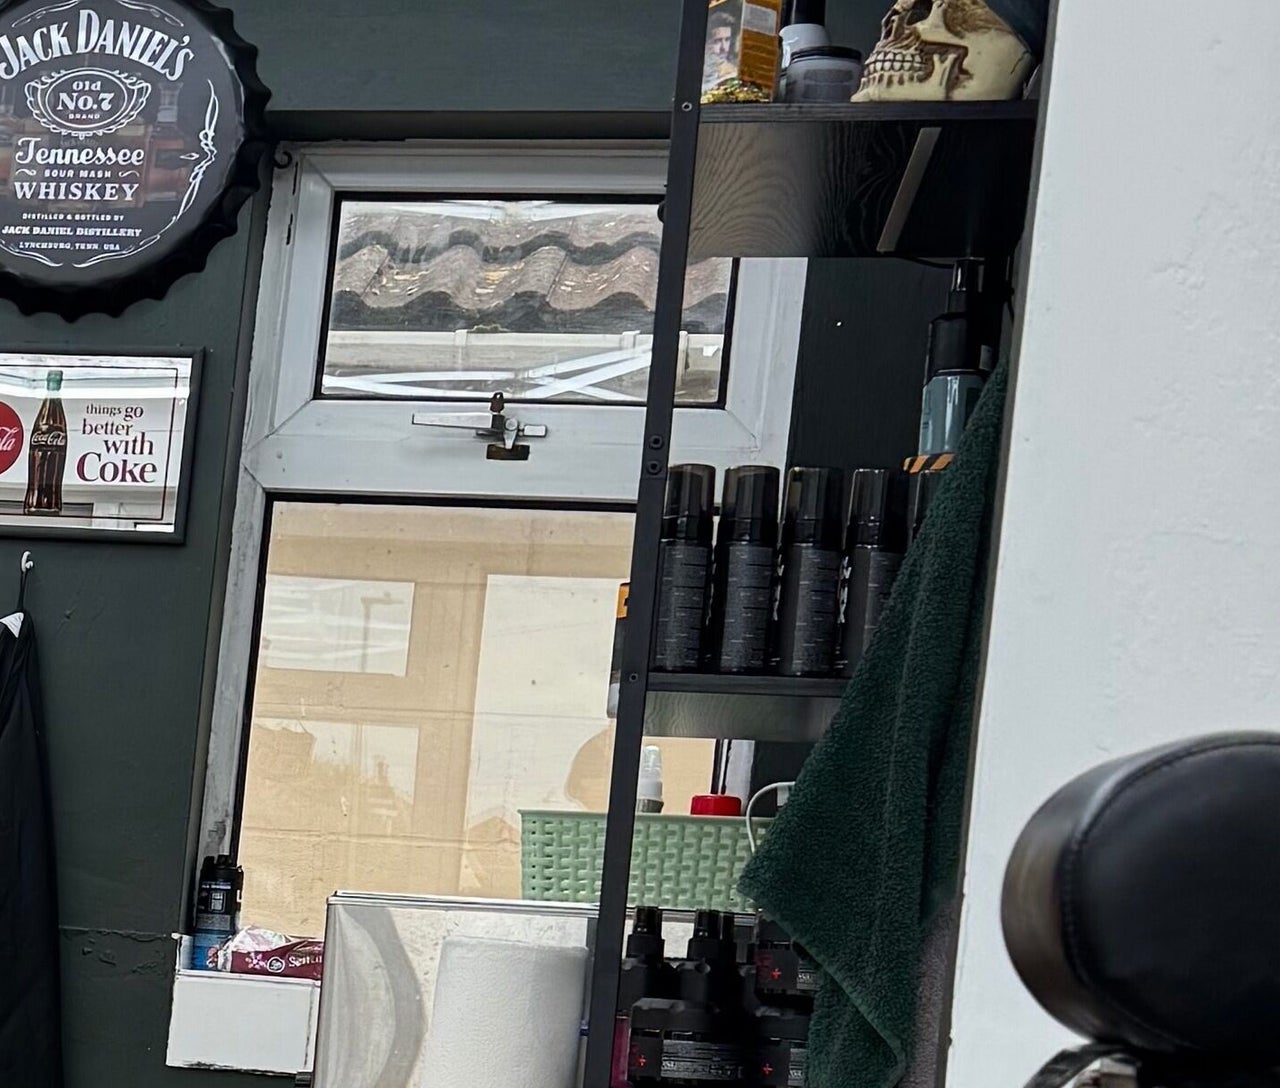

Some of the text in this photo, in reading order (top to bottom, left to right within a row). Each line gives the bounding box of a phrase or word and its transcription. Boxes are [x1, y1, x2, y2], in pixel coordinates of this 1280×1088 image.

[76, 9, 195, 82] DANIEL'S
[72, 80, 101, 92] Old
[56, 92, 115, 112] No.7
[15, 137, 145, 165] Tennessee
[44, 169, 111, 178] SOUR MASH
[14, 181, 140, 201] WHISKEY
[2, 226, 142, 237] JACK DANIEL DISTILLERY
[85, 403, 144, 422] things go
[82, 418, 133, 437] better
[104, 432, 154, 456] with
[77, 452, 158, 484] Coke
